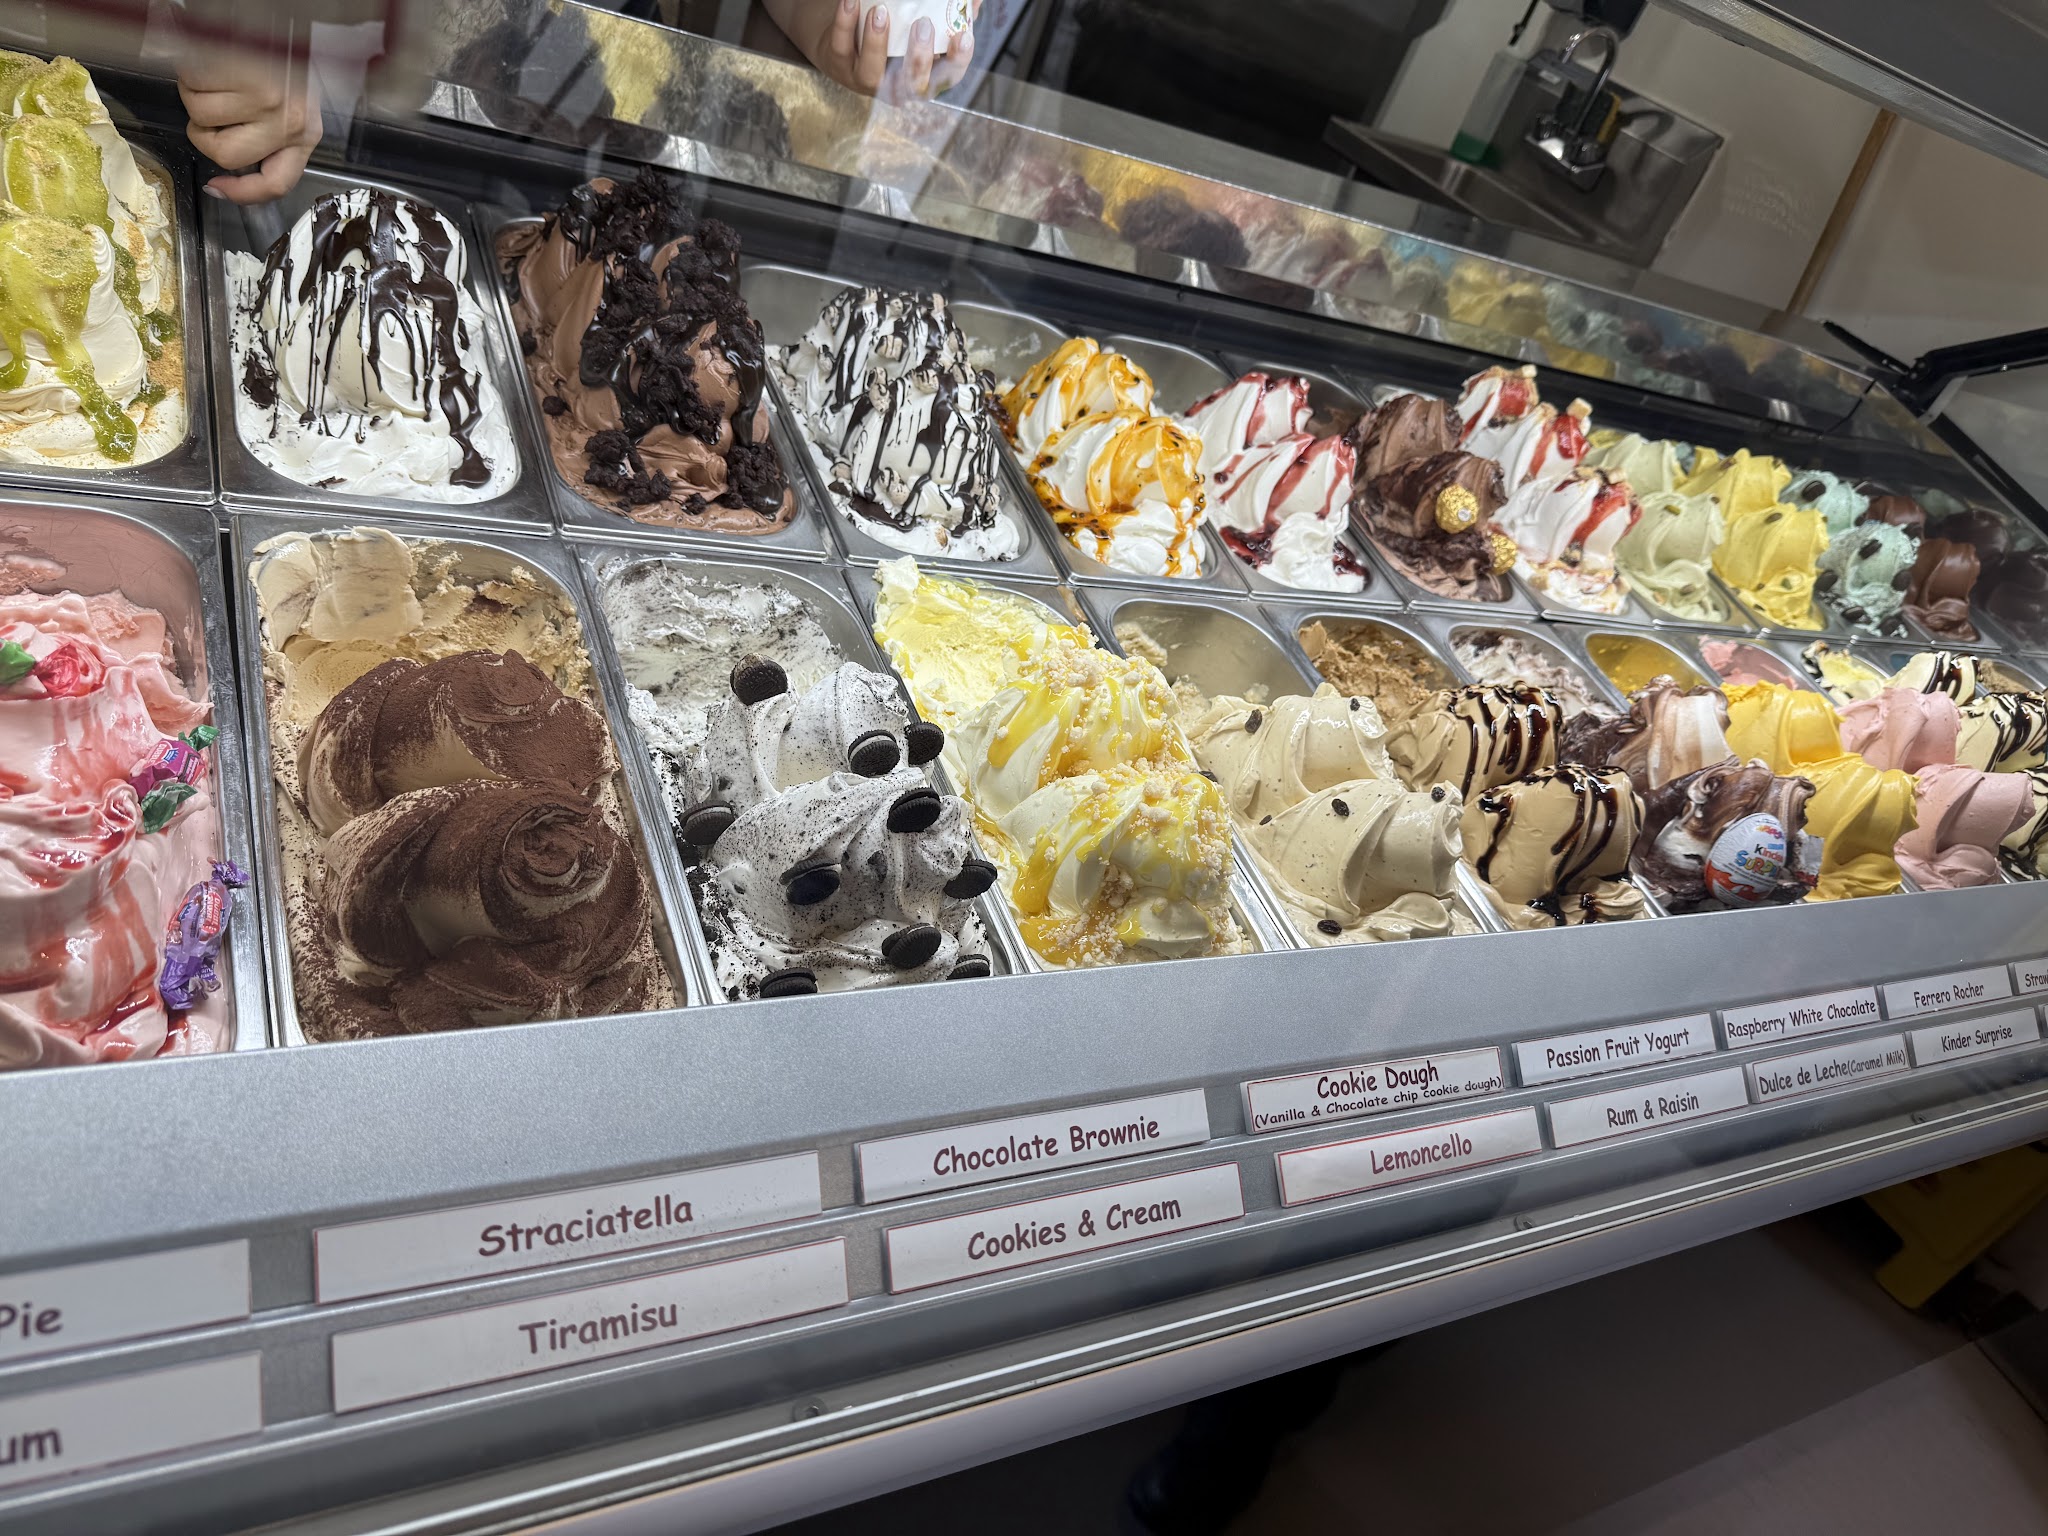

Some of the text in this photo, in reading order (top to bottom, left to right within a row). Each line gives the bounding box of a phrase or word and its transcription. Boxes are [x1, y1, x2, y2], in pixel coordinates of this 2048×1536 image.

[1913, 982, 1985, 1008] Ferrero Rocher
[2024, 970, 2048, 988] Straw
[1727, 1000, 1877, 1040] Raspberry White Chocolate
[1941, 1024, 2013, 1053] Kinder Surprise
[1546, 1028, 1690, 1069] Passion Fruit Yogurt
[1317, 1060, 1440, 1100] Cookie Dough
[1759, 1071, 1793, 1095] Dulce
[1797, 1068, 1812, 1085] de
[1886, 1049, 1907, 1067] Milk)
[1255, 1075, 1503, 1129] (Vanilla & Chocolate chip cookie dough)
[1607, 1093, 1699, 1128] Rum & Raisin
[933, 1116, 1160, 1176] Chocolate Brownie
[1370, 1132, 1472, 1175] Lemoncello
[478, 1194, 694, 1258] Straciatella
[967, 1197, 1182, 1261] Cookies & Cream
[518, 1302, 679, 1354] Tiramisu
